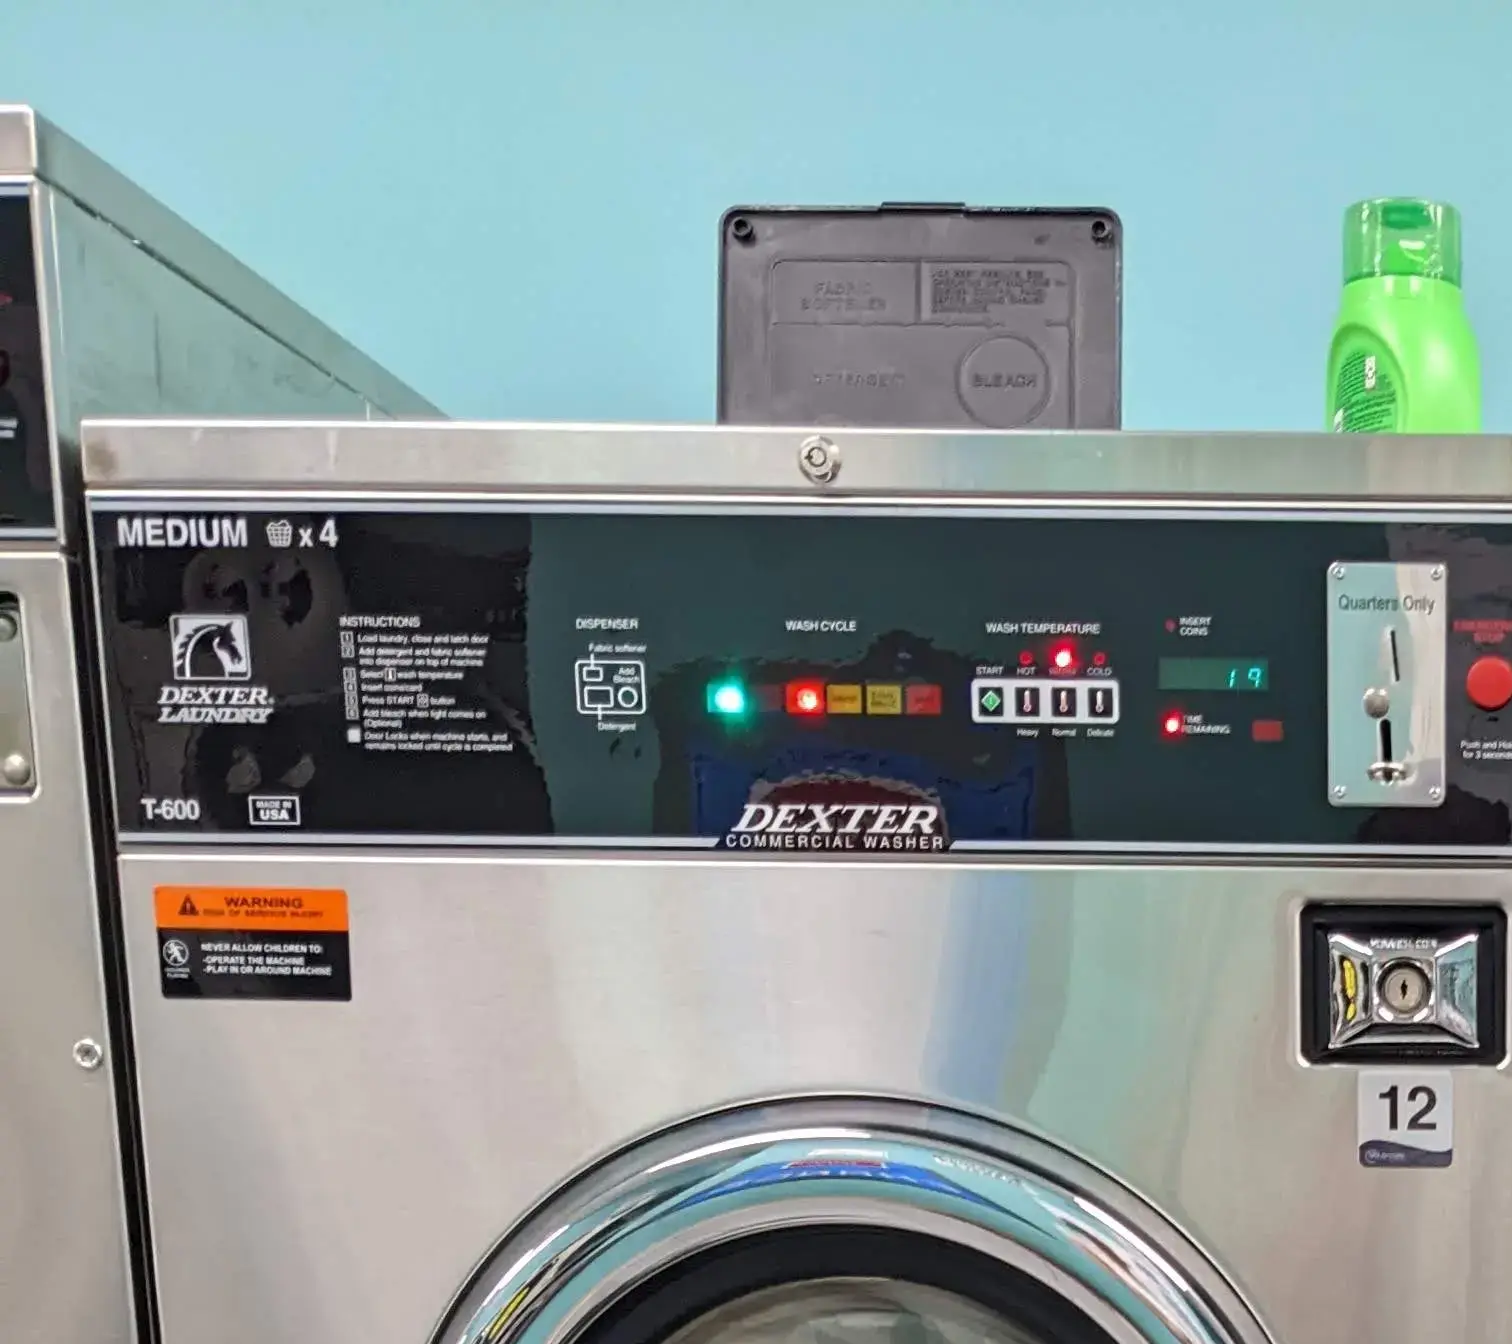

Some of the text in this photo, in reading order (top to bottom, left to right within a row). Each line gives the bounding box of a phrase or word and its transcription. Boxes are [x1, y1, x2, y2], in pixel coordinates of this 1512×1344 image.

[117, 518, 337, 547] MEDIUM x 4
[1338, 595, 1435, 615] Quarters Only
[339, 616, 420, 627] INSTRUCTIONS
[576, 619, 638, 630] DISPENSER
[785, 621, 856, 631] WASH CYCLE
[986, 622, 1100, 634] WASH TEMPERATURE
[157, 686, 267, 705] DEXTER
[158, 707, 274, 723] LAUNDRY
[140, 798, 199, 820] T-600
[260, 809, 289, 821] USA
[731, 803, 940, 834] DEXTER
[726, 834, 944, 849] COMMERCIAL WASHER
[224, 896, 304, 909] WARNING
[1379, 1085, 1437, 1131] 12
